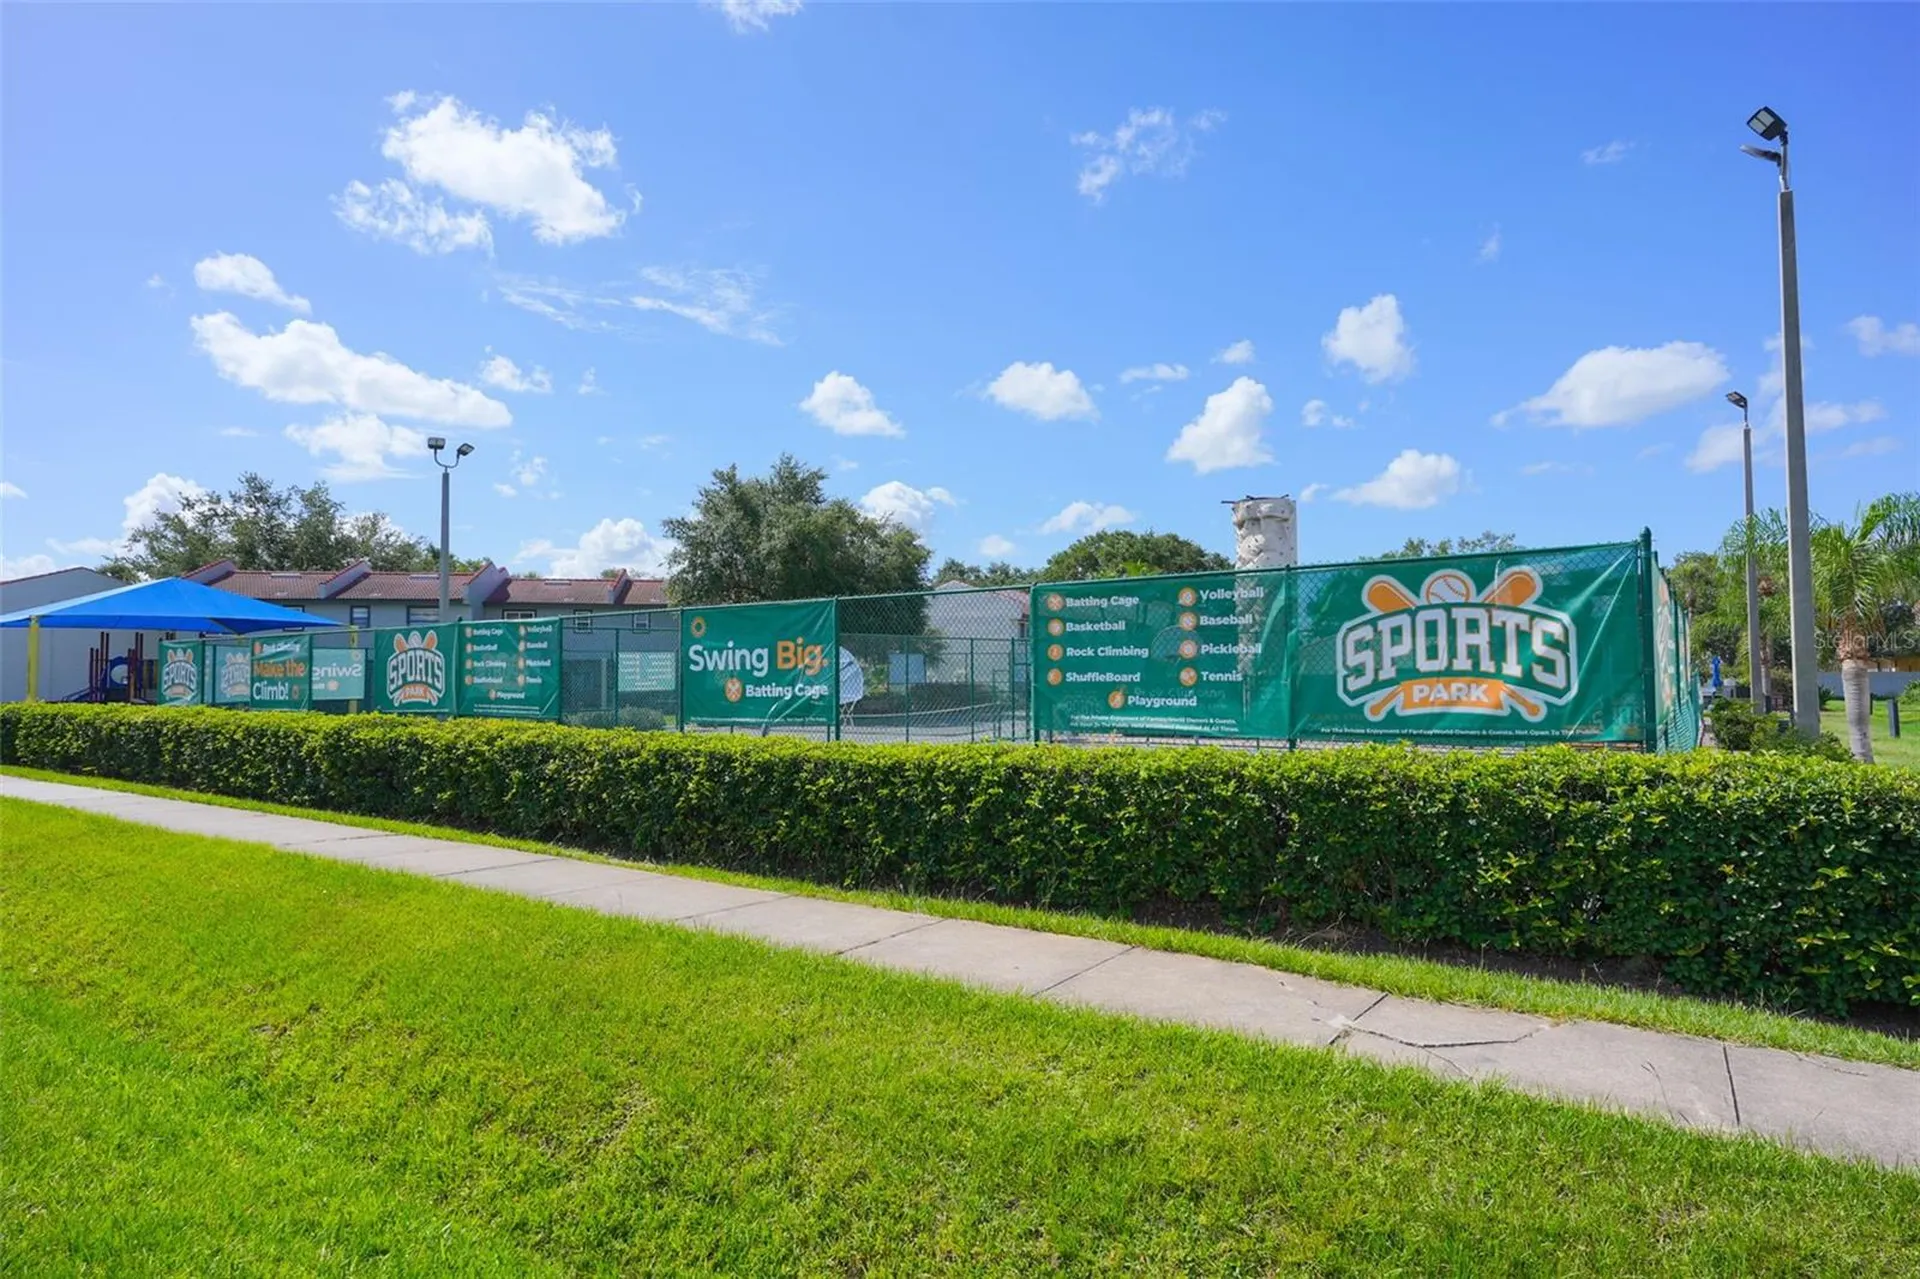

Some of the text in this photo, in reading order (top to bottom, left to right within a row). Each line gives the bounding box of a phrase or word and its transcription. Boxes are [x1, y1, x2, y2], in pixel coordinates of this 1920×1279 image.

[1066, 595, 1139, 608] Batting Cage
[1200, 587, 1264, 602] Volleyball
[1066, 621, 1126, 632] Basketball
[1200, 614, 1252, 626] Baseball
[1066, 646, 1149, 659] Rock Climbing
[1201, 643, 1262, 655] Pickleball
[1346, 607, 1568, 692] SPORTS
[689, 640, 769, 677] Swing
[776, 637, 829, 676] Big.
[163, 661, 197, 688] SPORTS
[254, 660, 306, 677] Make the
[389, 650, 444, 694] SPORTS
[1066, 672, 1141, 683] ShuffleBoard
[1201, 671, 1243, 682] Tennis
[252, 681, 289, 701] Climb!
[745, 683, 829, 701] Batting Cage
[1412, 682, 1490, 703] PARK
[1127, 694, 1198, 709] Playground
